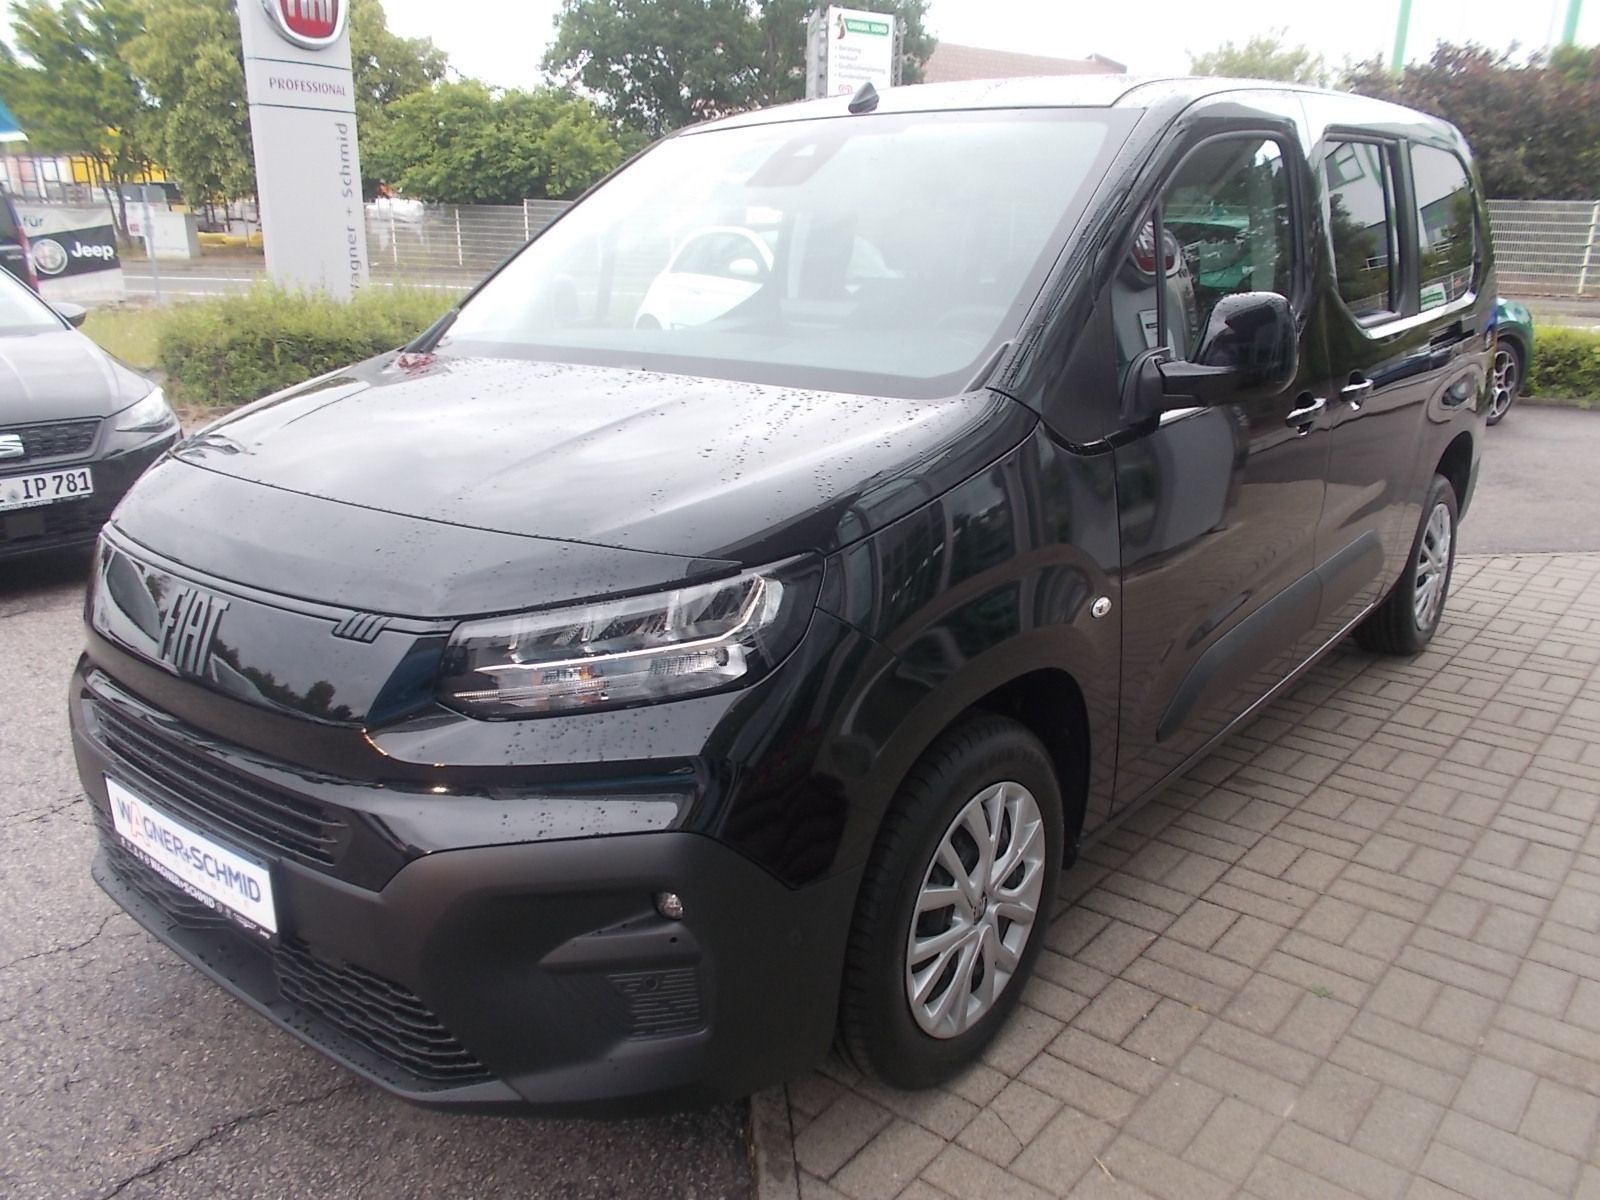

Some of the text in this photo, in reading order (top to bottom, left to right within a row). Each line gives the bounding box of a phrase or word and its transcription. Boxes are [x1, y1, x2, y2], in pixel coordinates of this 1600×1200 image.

[268, 76, 347, 97] PROFESSIONAL
[335, 122, 354, 198] Schmid
[71, 241, 115, 261] Jeep
[346, 226, 362, 289] agner
[22, 477, 47, 500] IP
[52, 471, 91, 495] 781
[159, 586, 231, 677] FIAT
